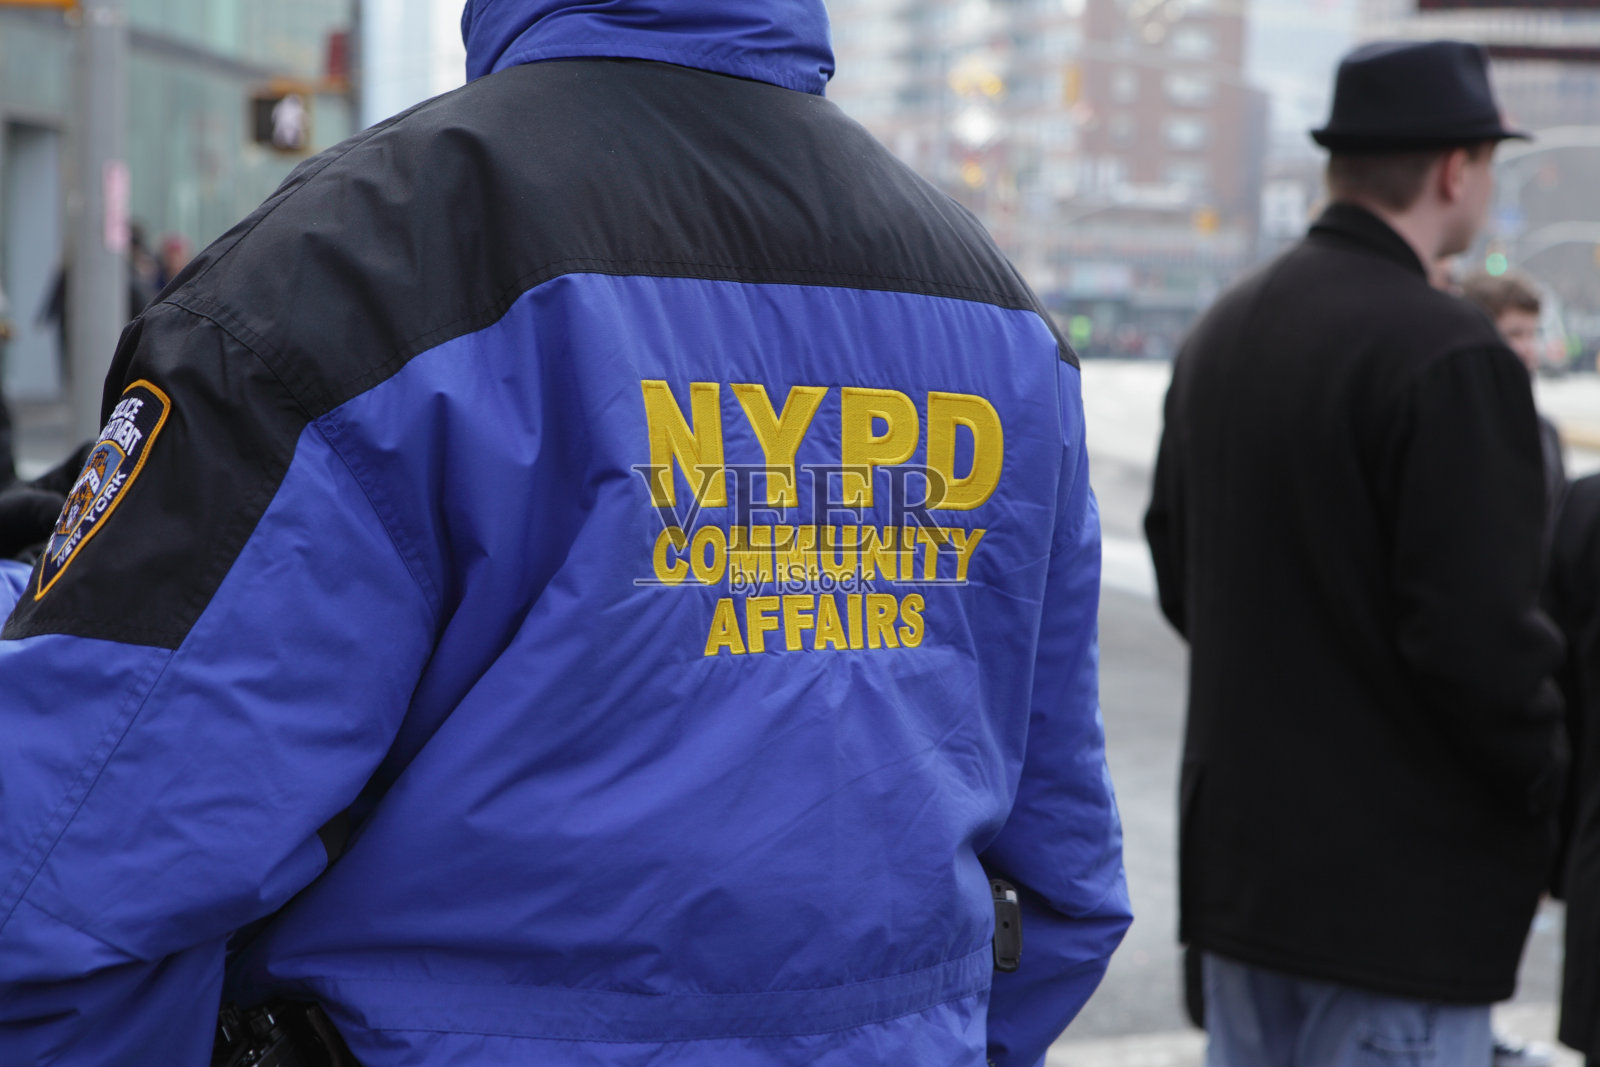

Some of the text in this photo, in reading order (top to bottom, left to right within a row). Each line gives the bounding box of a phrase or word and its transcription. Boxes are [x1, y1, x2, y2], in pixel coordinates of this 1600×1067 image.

[640, 379, 1004, 511] NYPD
[56, 469, 127, 568] NEW YORK
[652, 524, 987, 587] COMMUNITY
[704, 593, 926, 656] AFFAIRS
